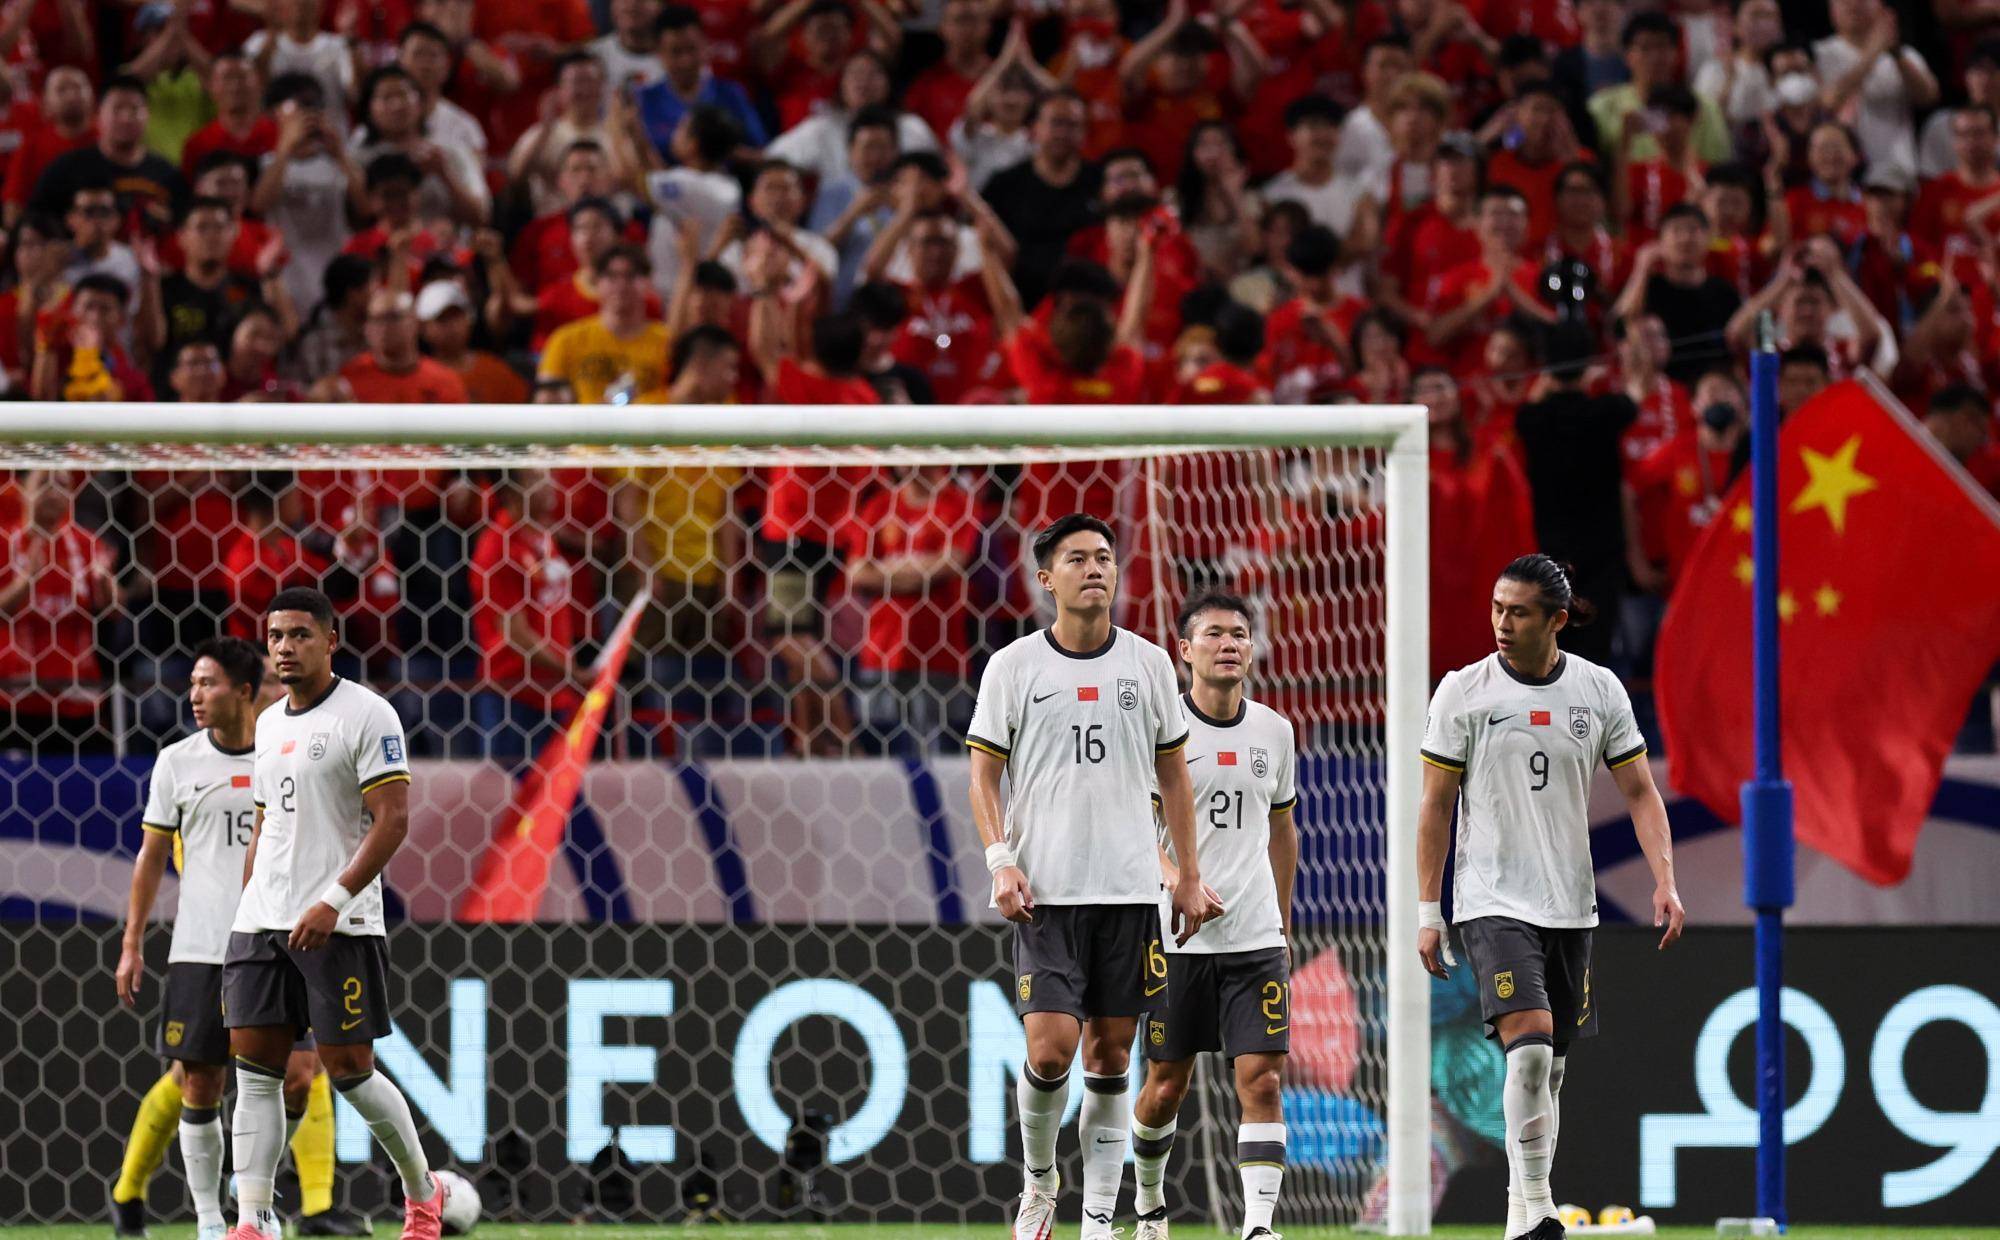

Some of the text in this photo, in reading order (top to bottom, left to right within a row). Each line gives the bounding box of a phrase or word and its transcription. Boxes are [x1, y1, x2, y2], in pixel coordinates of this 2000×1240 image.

[1071, 724, 1106, 764] 16
[1529, 750, 1549, 792] 9
[280, 776, 295, 812] 2
[1210, 790, 1243, 829] 21
[224, 811, 253, 847] 15
[1143, 938, 1168, 981] 16
[343, 976, 362, 1015] 2
[1262, 980, 1290, 1020] 21
